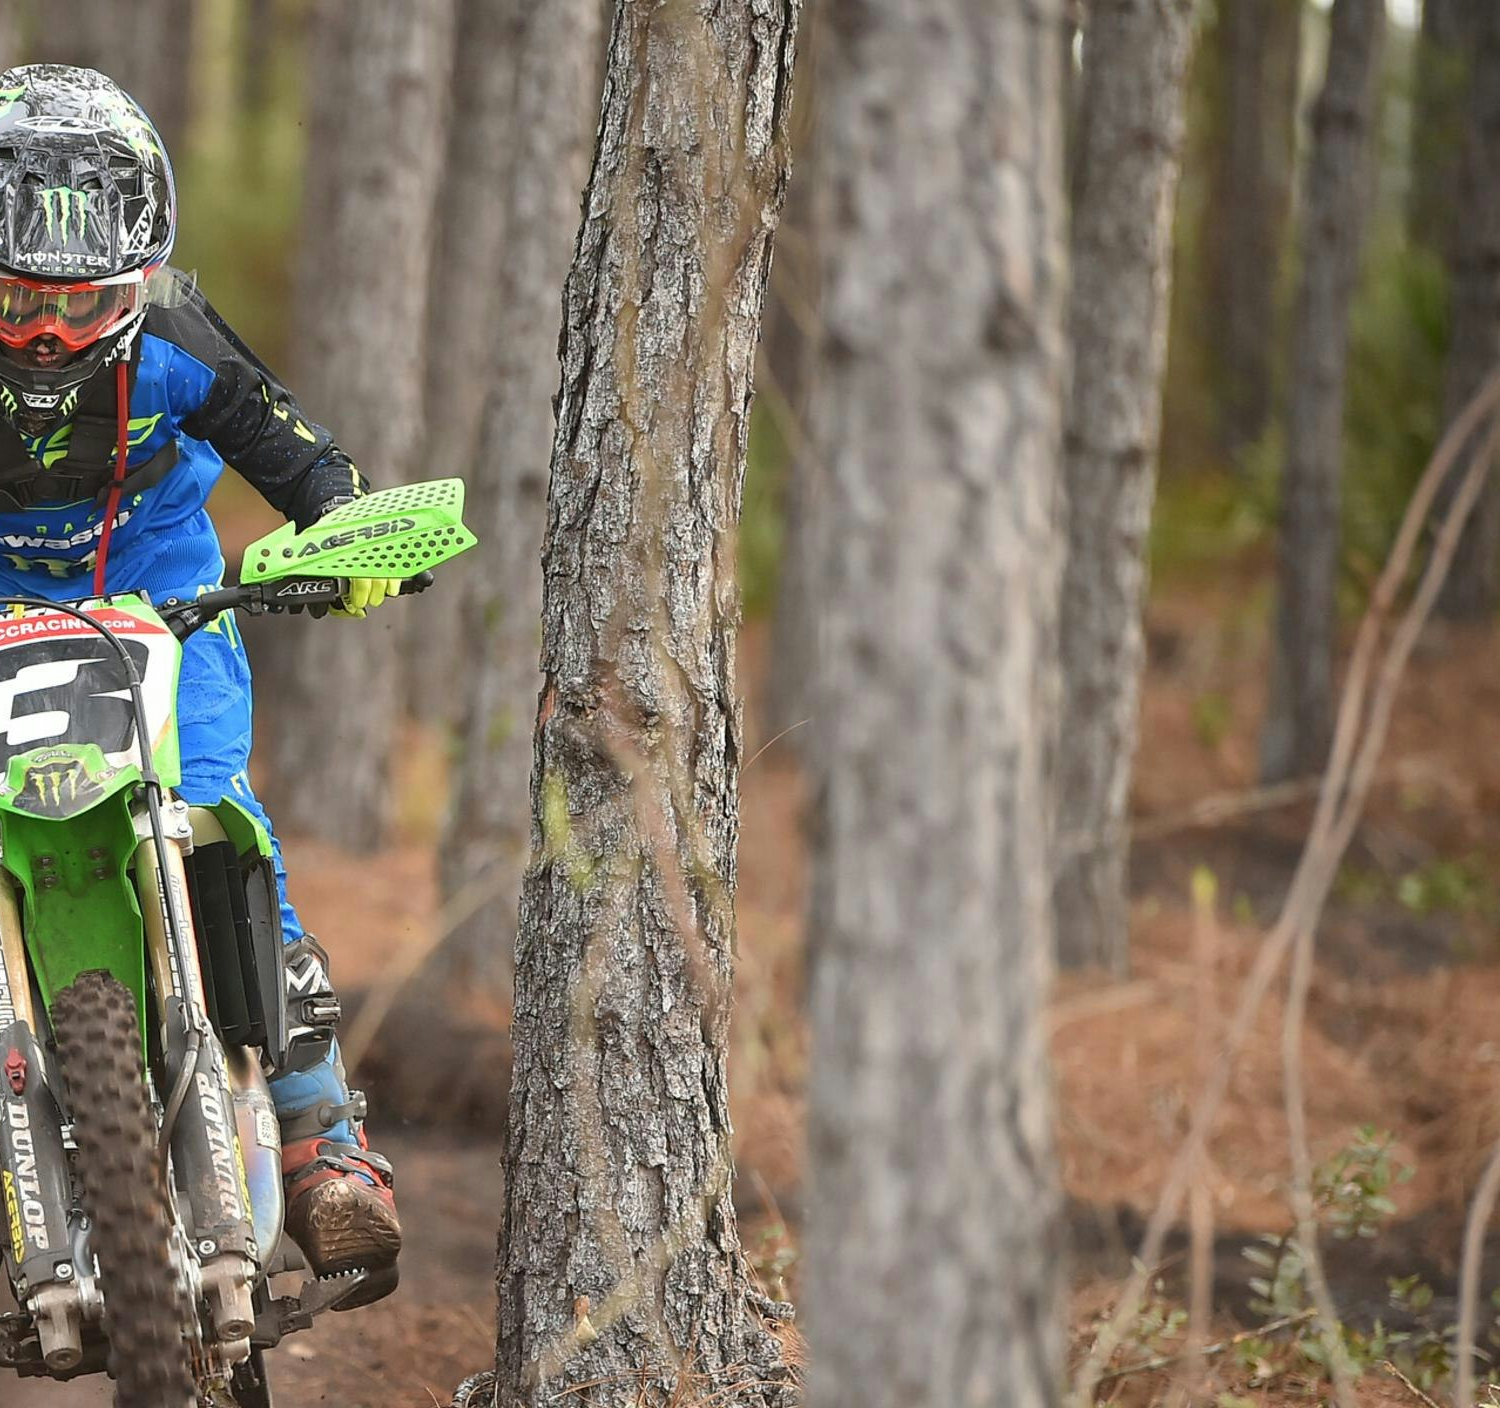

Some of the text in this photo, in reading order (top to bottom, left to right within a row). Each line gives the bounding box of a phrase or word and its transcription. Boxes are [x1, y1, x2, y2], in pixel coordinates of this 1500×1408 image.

[16, 250, 111, 268] MONSTER
[30, 265, 98, 274] ENERGY
[297, 518, 415, 557] ACERBIS
[277, 580, 334, 597] ARC
[196, 1072, 241, 1220] DUNLOP
[7, 1101, 50, 1250] DUNLOP
